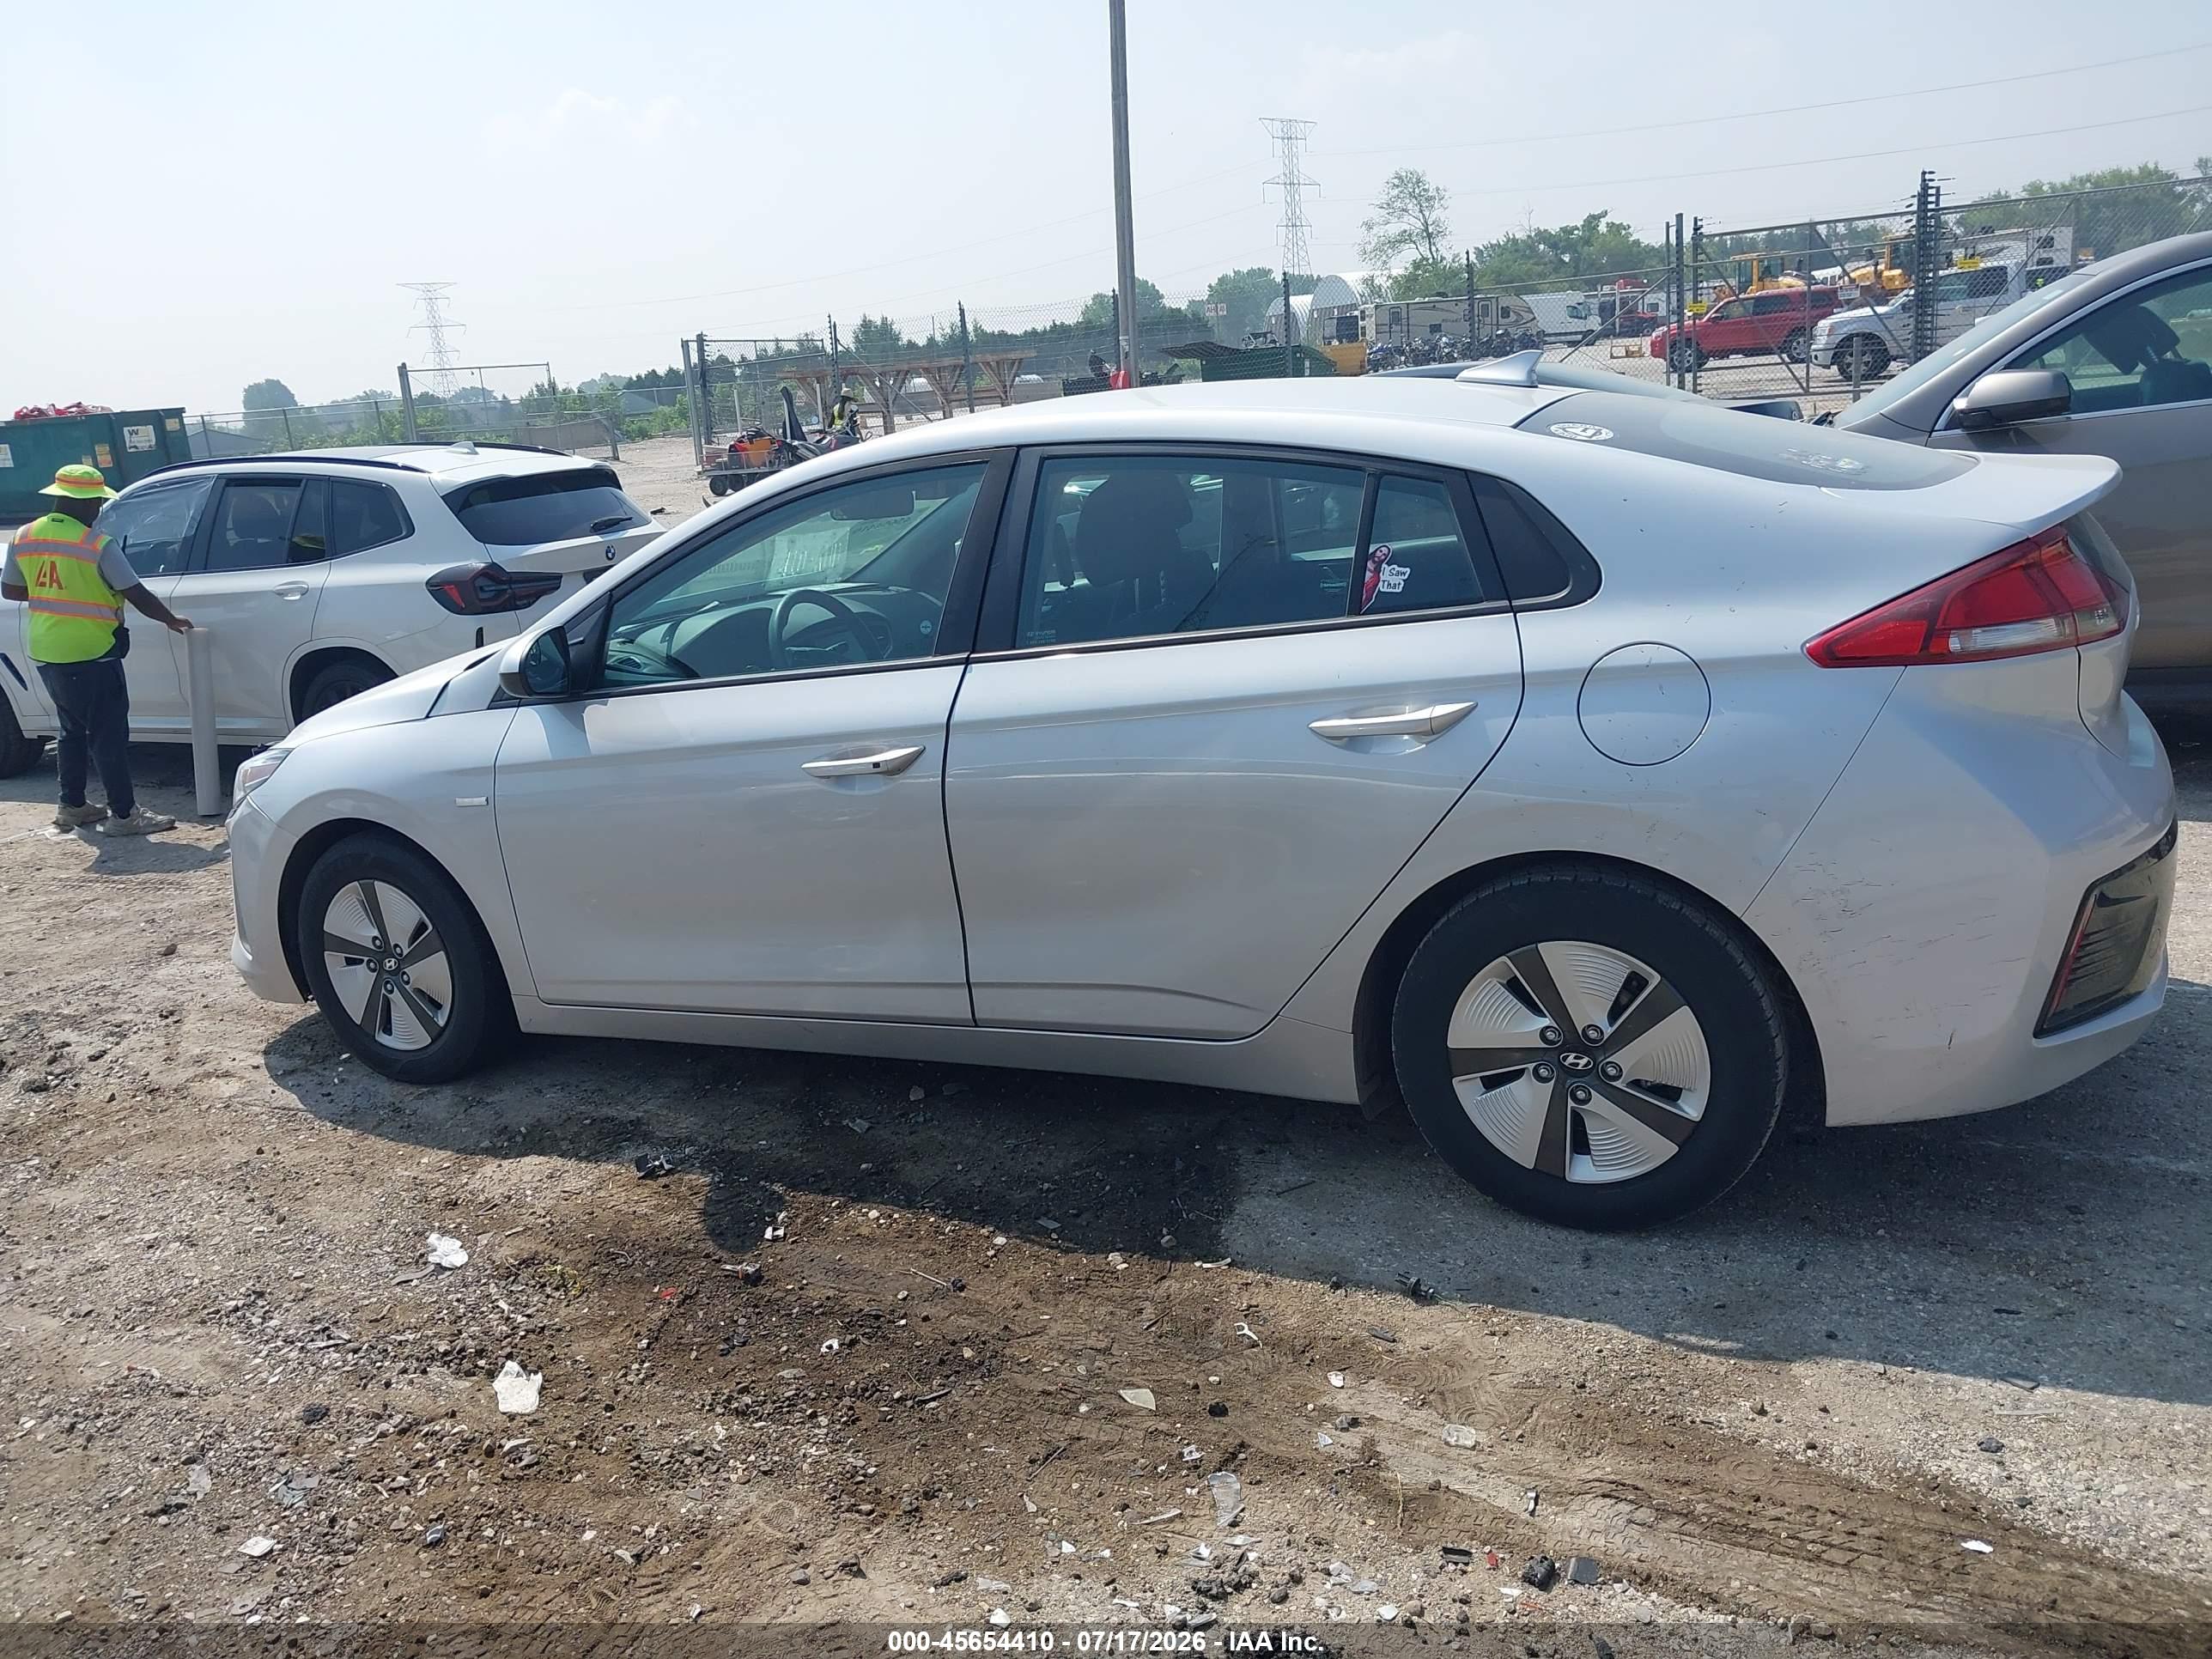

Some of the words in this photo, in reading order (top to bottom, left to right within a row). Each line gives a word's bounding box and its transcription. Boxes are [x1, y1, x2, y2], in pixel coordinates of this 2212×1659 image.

[1382, 567, 1386, 576] I
[1388, 568, 1408, 577] Saw
[1381, 580, 1401, 591] That
